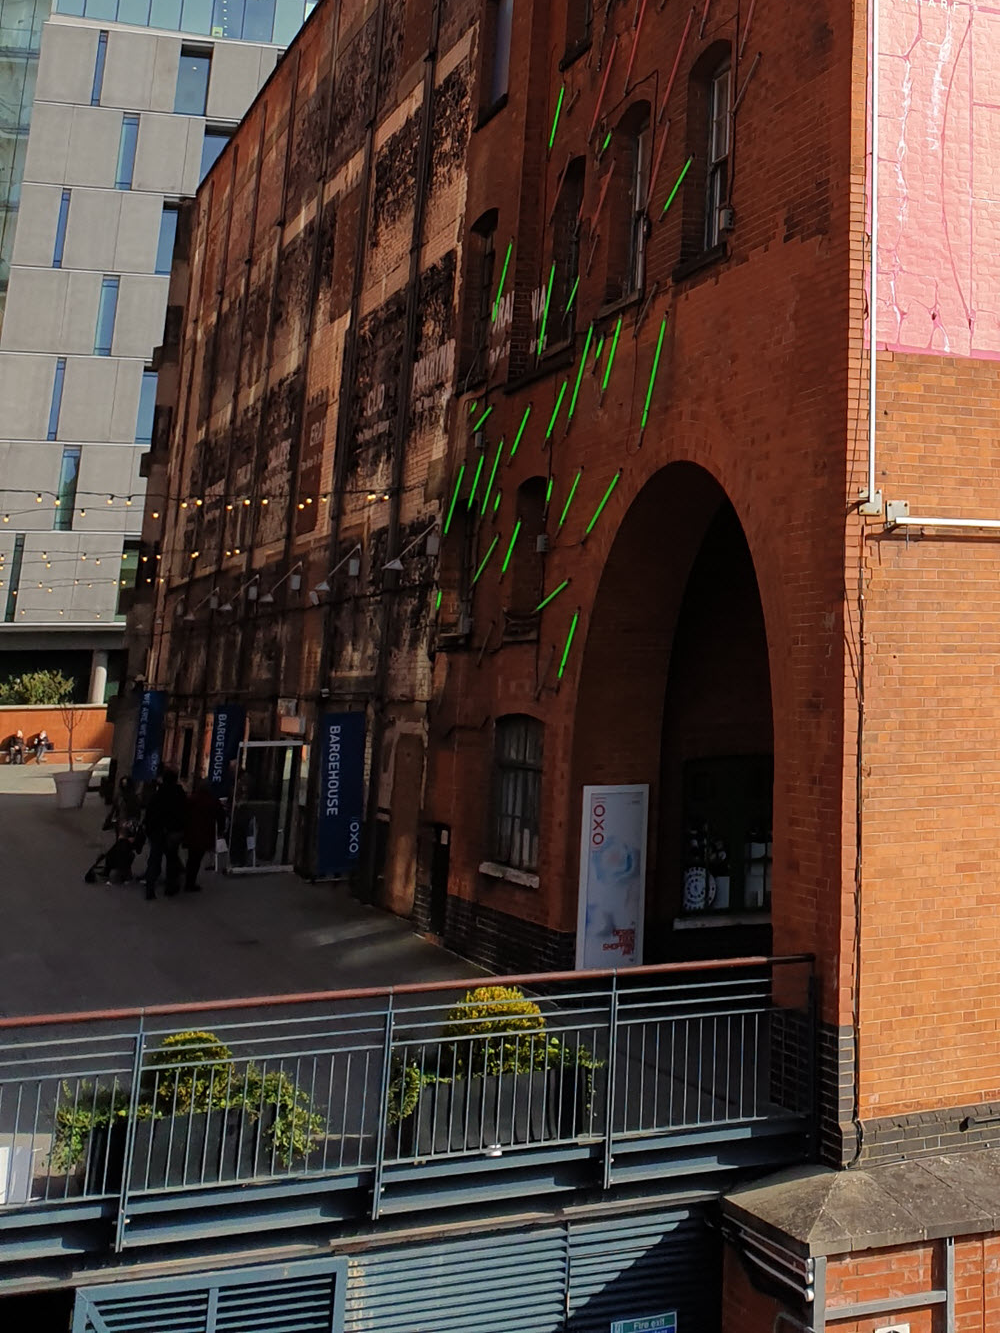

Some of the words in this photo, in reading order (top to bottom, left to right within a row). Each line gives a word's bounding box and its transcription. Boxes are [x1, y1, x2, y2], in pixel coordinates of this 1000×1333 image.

[326, 725, 342, 817] BARGEHOUSE
[348, 821, 360, 854] OXO
[592, 804, 606, 845] OXO
[633, 1321, 649, 1331] Fire
[651, 1318, 665, 1329] exit
